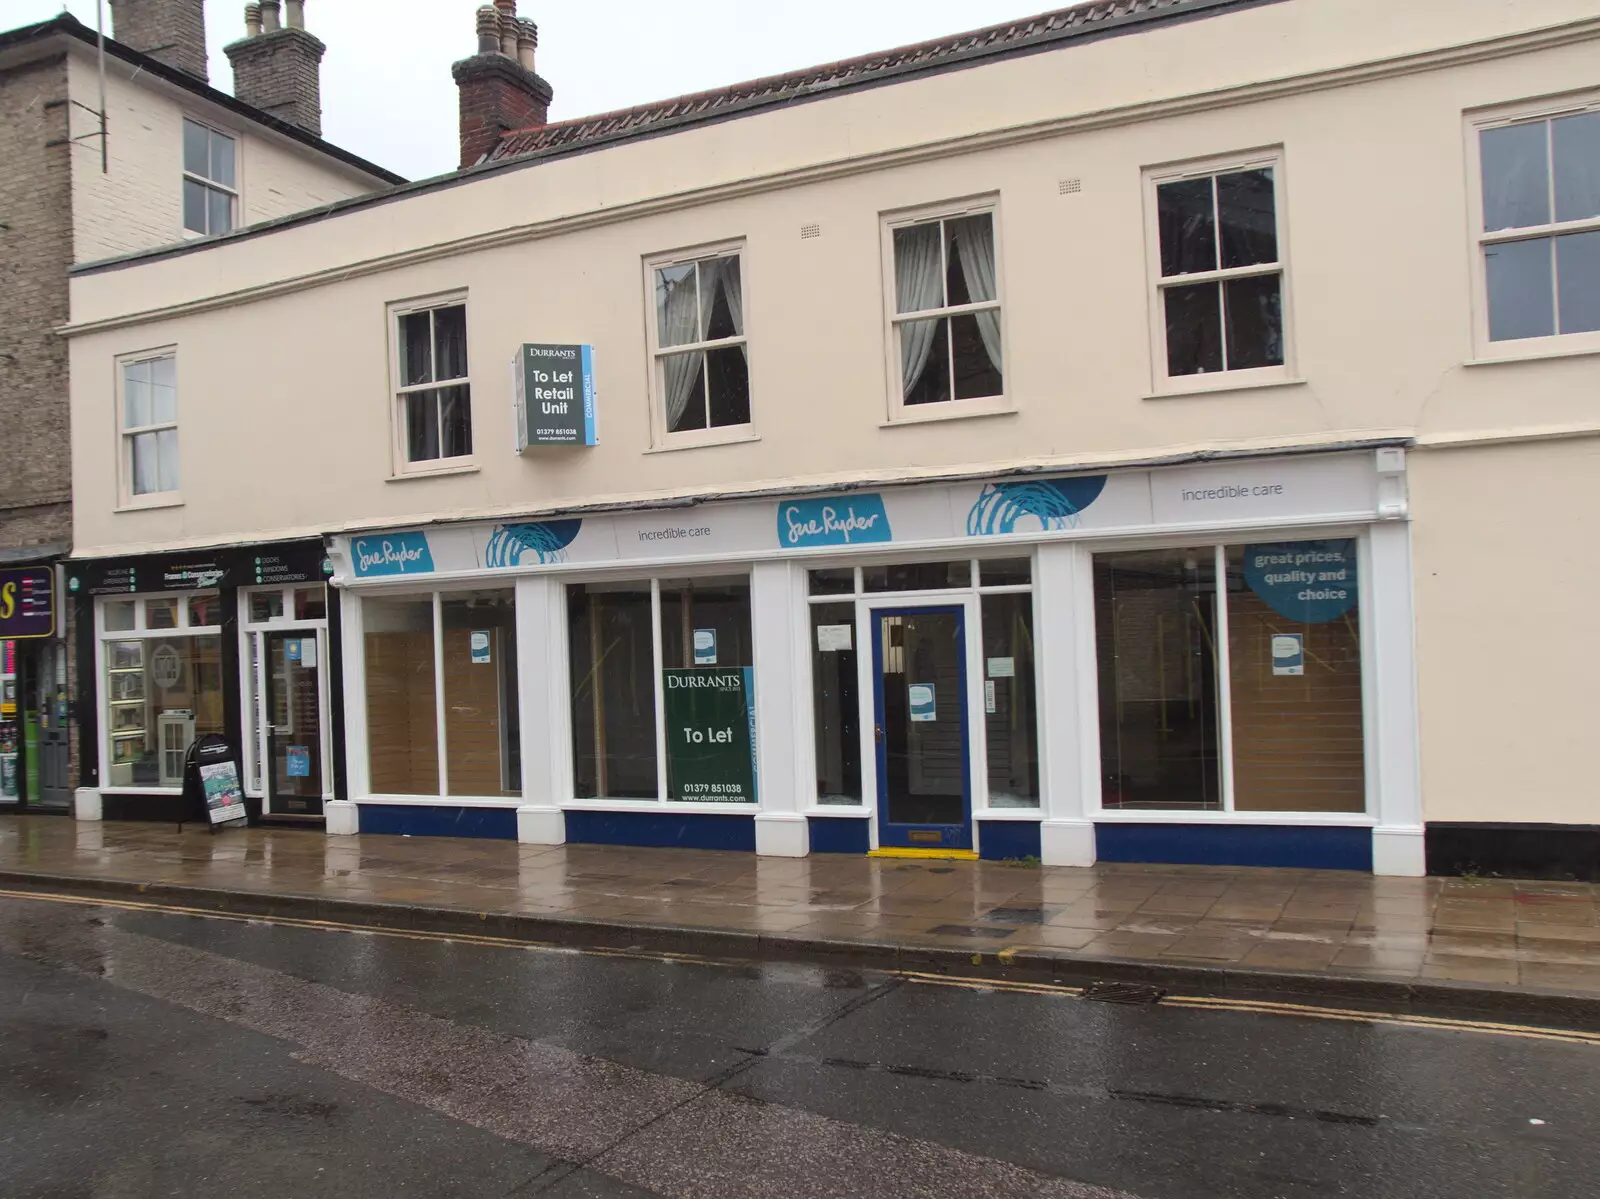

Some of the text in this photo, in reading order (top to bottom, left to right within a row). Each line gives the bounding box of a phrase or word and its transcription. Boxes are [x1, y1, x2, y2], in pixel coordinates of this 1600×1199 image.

[530, 348, 576, 357] DURRANTS
[533, 370, 573, 383] To Let
[534, 387, 574, 400] Retail
[584, 373, 593, 418] COMMERCIAL
[541, 402, 568, 414] Unit
[1182, 483, 1283, 501] incredible care
[785, 506, 879, 543] Sue Ryder
[638, 527, 711, 540] incredible care
[356, 540, 424, 572] Sue Ryder
[1255, 553, 1293, 568] great
[1264, 569, 1346, 585] quality and
[1297, 588, 1347, 600] choice
[668, 675, 740, 688] DURRANTS
[684, 727, 733, 743] To Let
[684, 784, 742, 793] 01379 851038
[682, 794, 746, 802] www.durrants.com
